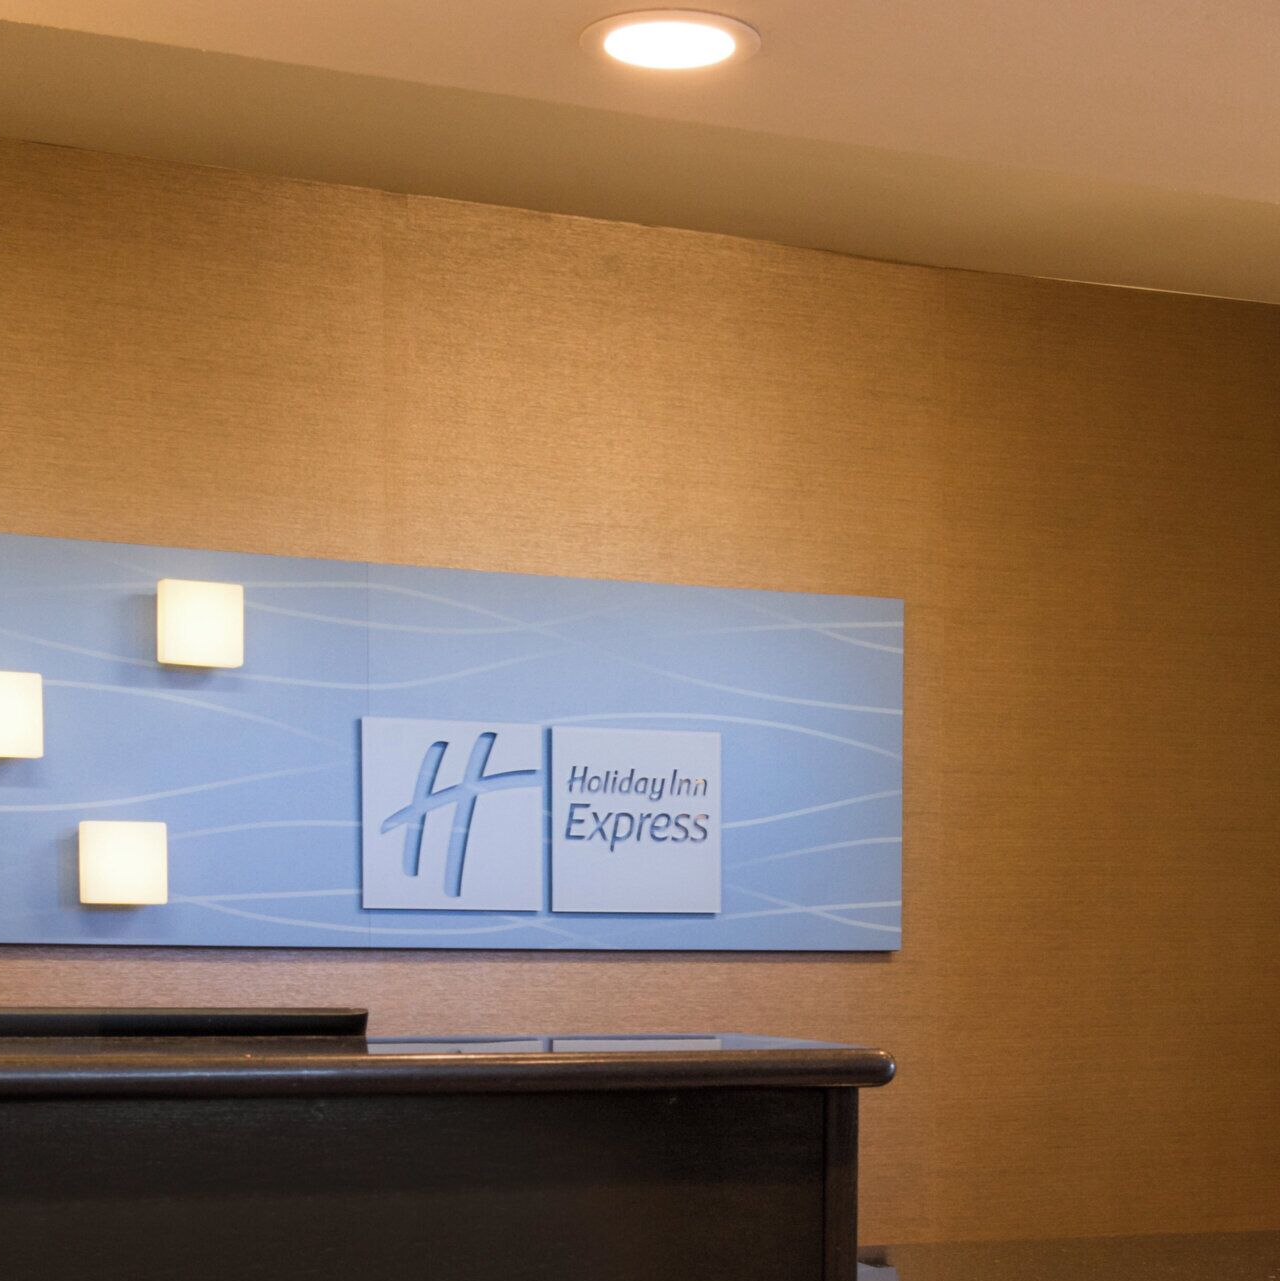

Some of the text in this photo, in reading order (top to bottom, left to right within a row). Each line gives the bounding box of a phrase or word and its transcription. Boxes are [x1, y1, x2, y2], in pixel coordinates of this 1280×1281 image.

[568, 765, 708, 800] Holiday Inn
[565, 803, 709, 852] Express
